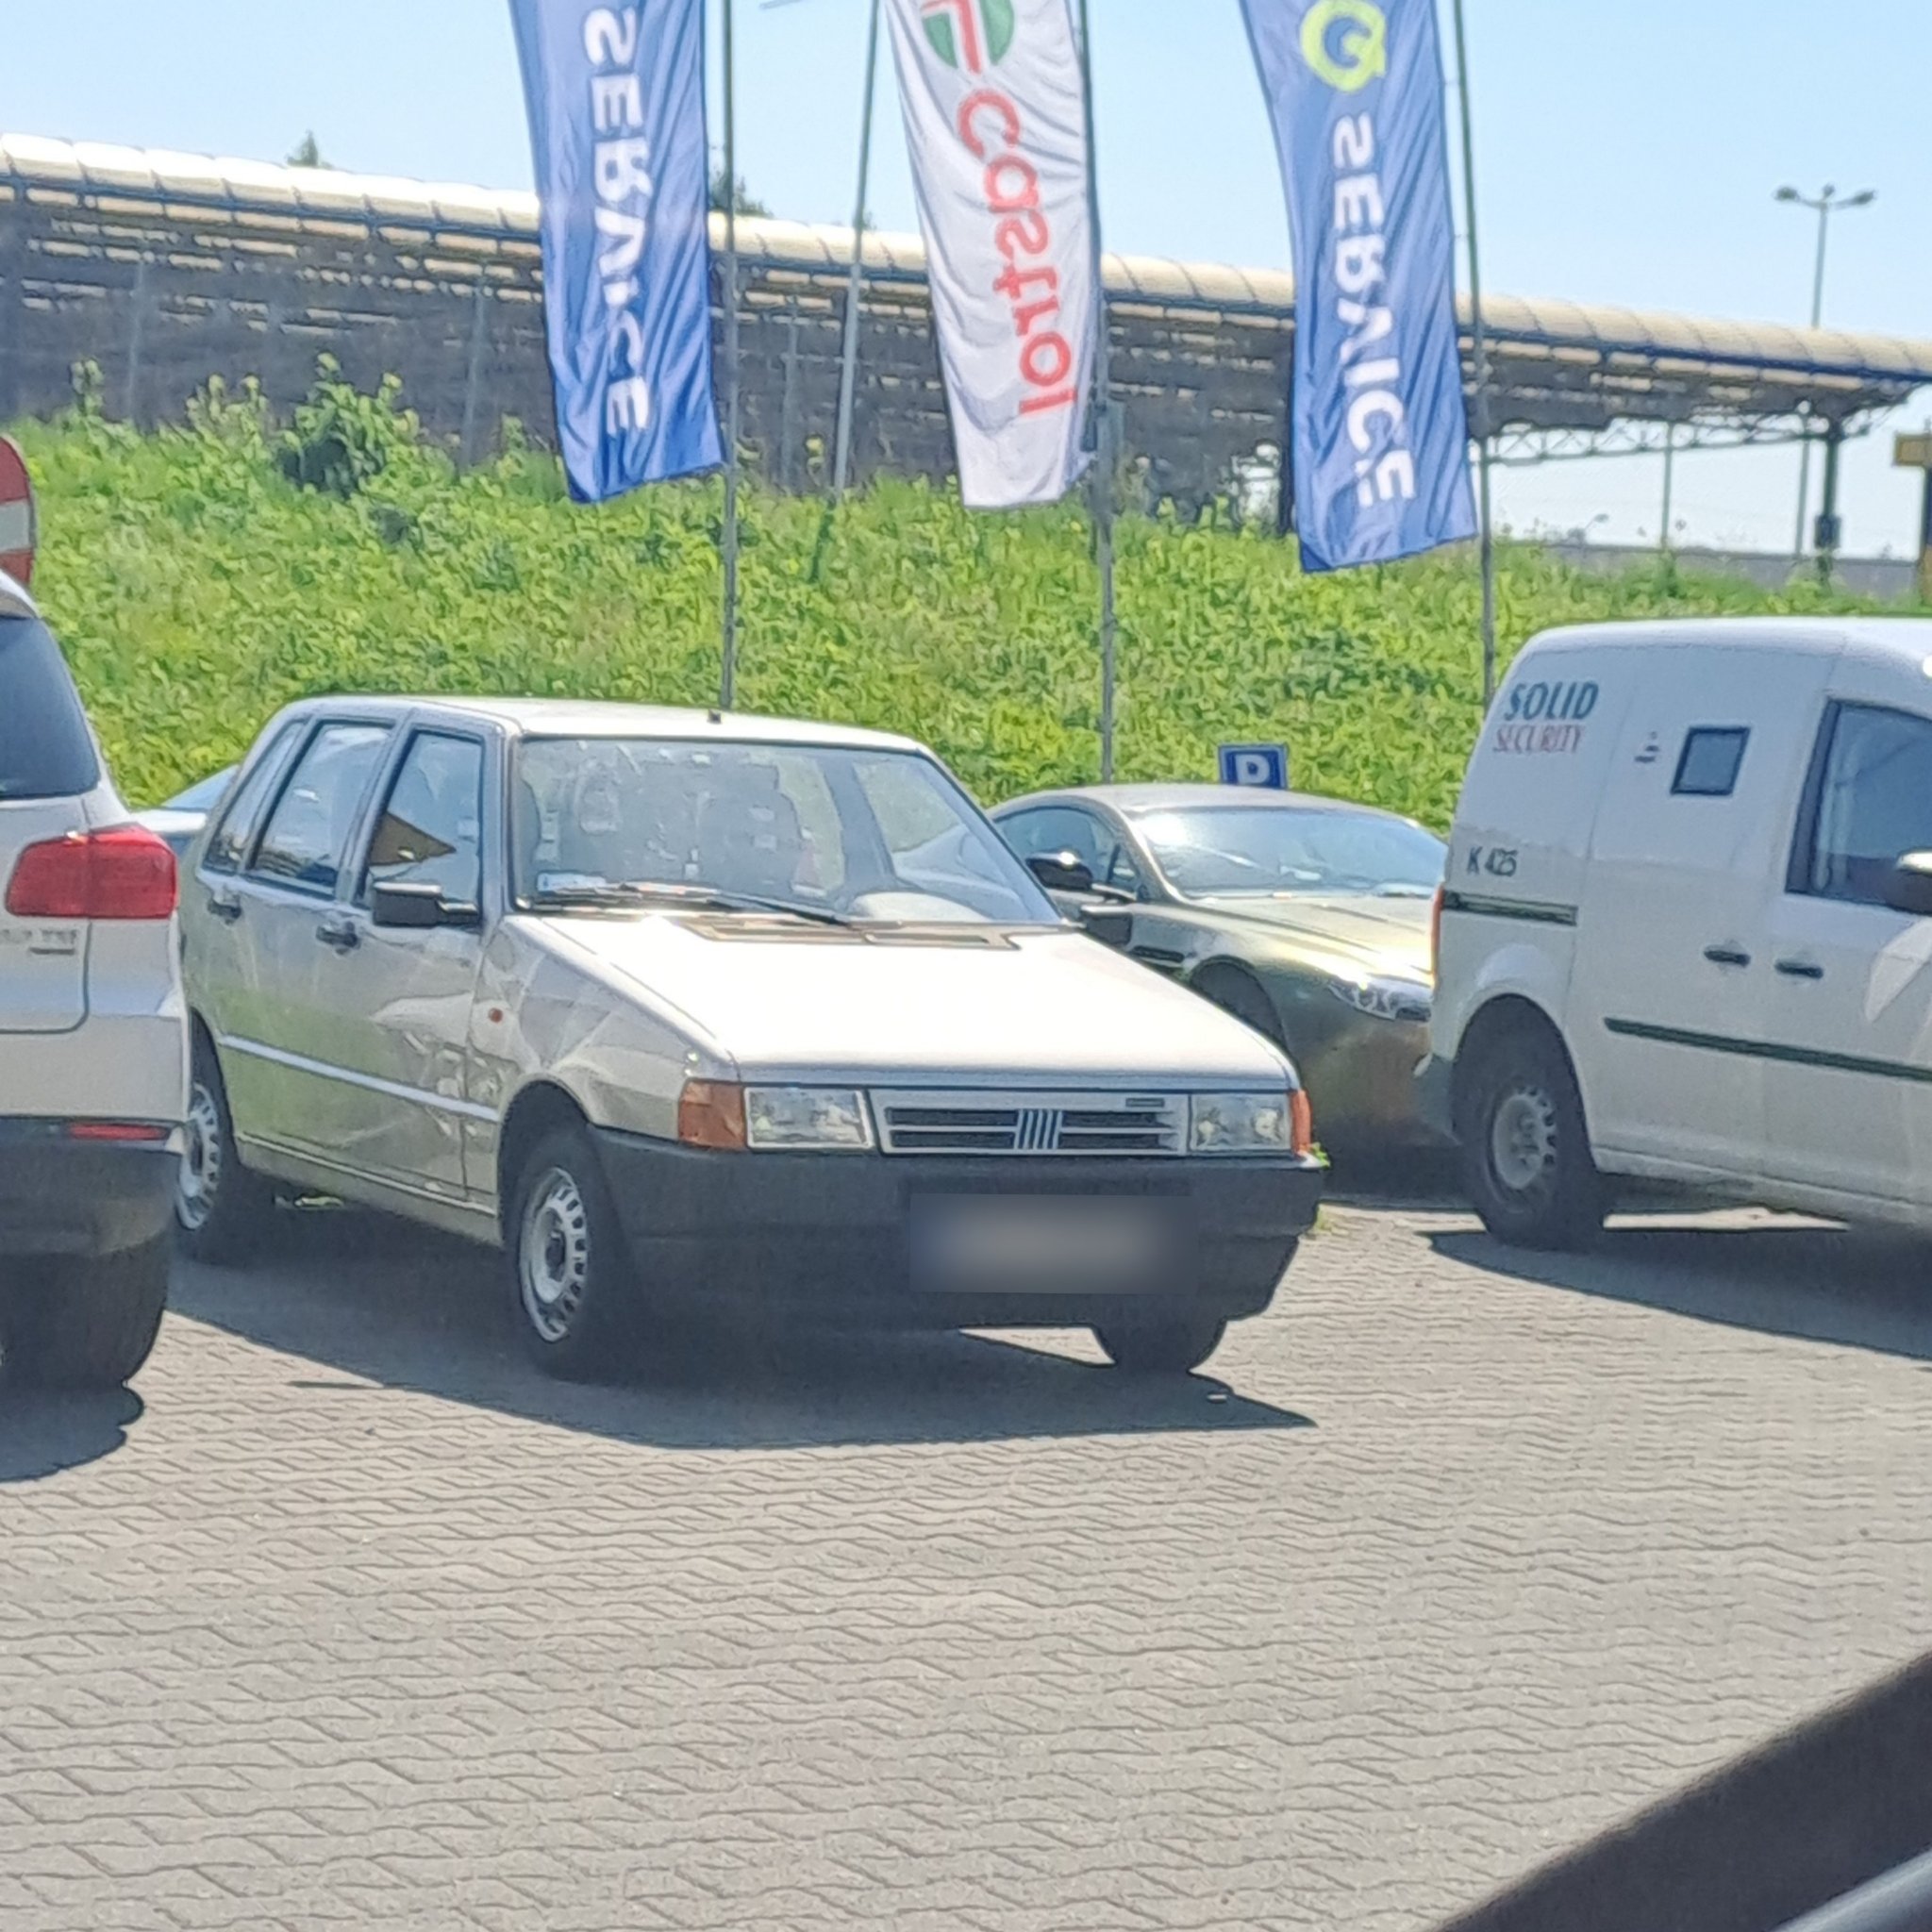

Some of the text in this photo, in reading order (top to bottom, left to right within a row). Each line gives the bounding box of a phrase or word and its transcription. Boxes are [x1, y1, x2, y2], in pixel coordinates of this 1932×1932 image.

[1504, 680, 1600, 722] SOLID
[1491, 724, 1586, 755] SECURITY
[1466, 846, 1483, 875] K
